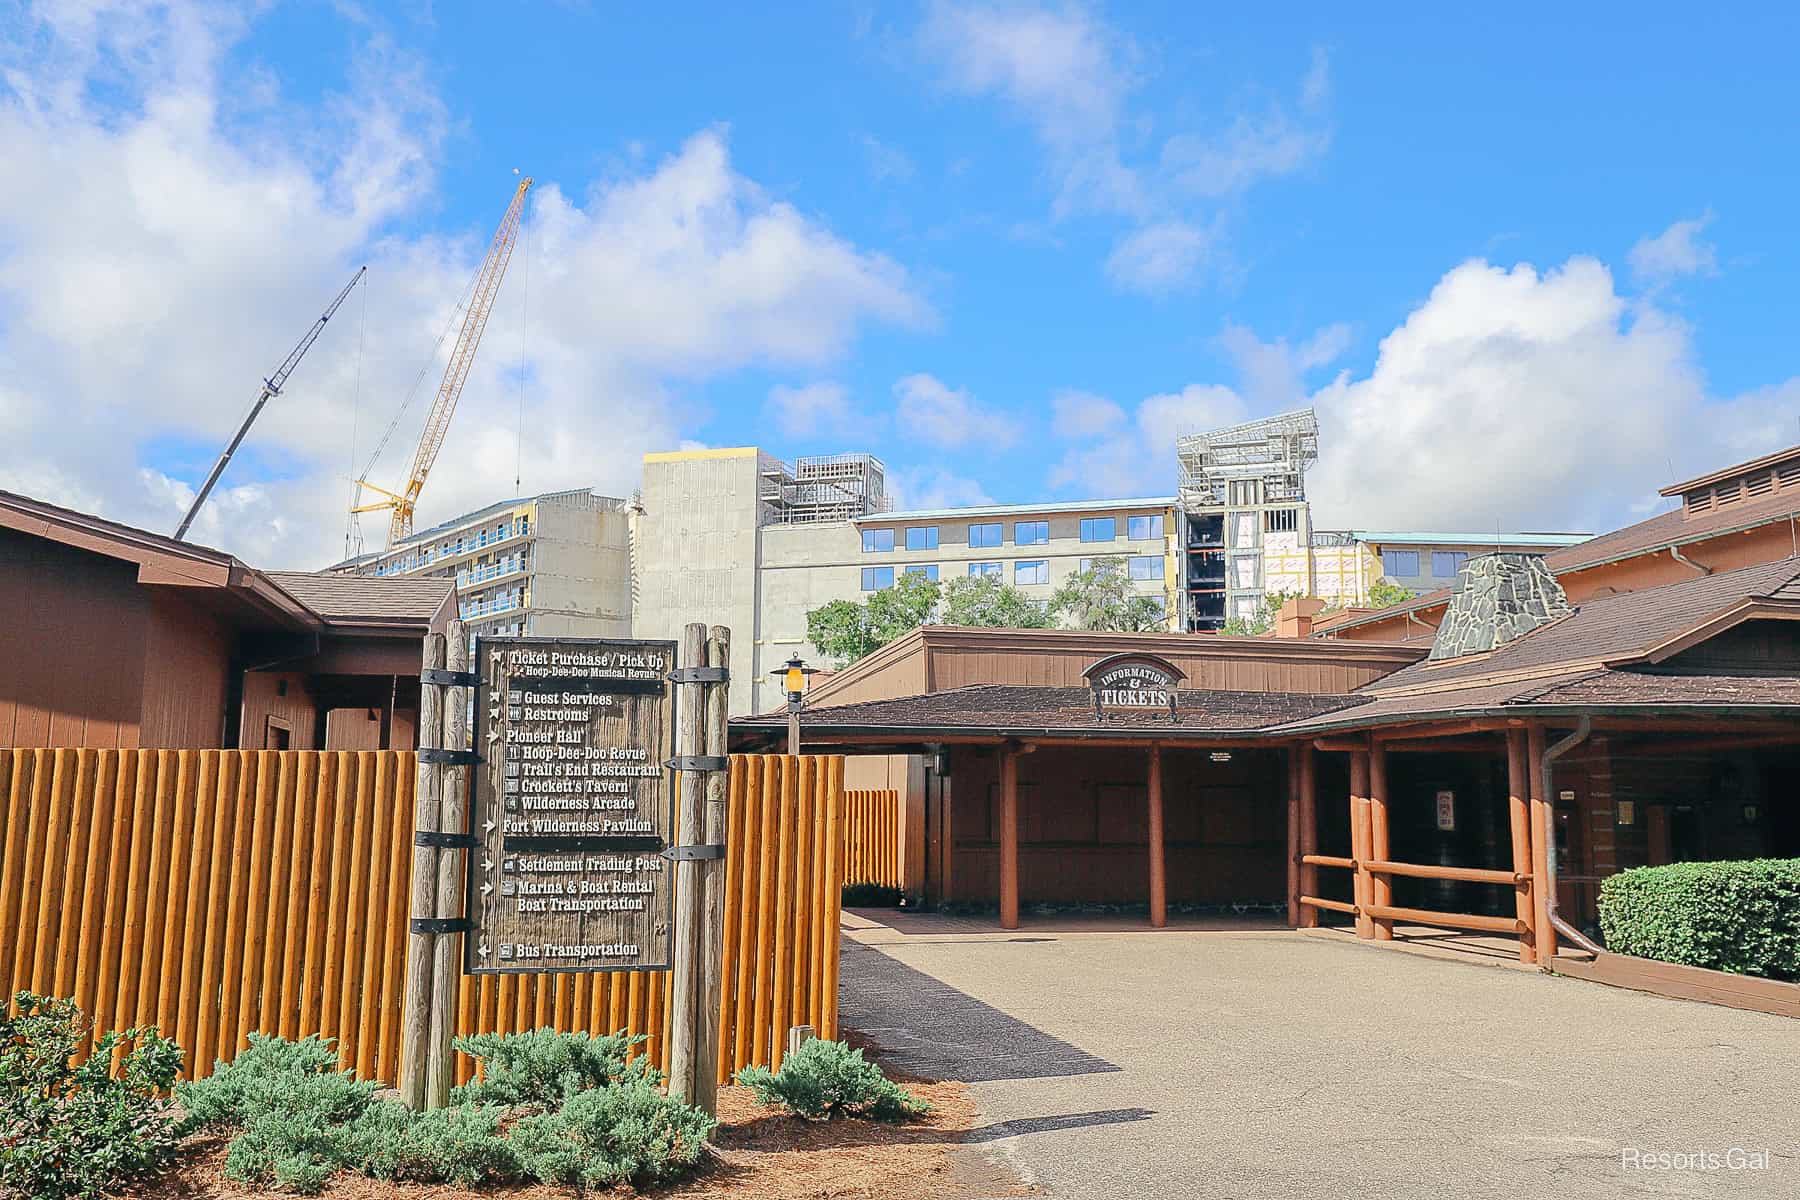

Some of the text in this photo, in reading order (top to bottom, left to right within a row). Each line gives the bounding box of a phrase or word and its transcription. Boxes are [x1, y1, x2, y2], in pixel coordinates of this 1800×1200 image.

[511, 652, 548, 665] Ticket
[552, 652, 608, 666] Purchase
[619, 654, 645, 667] Pick
[648, 654, 664, 670] Up
[526, 666, 657, 679] Hoop-Dee-Doo Musical Revue
[1101, 668, 1168, 686] INFORMATION
[1129, 678, 1141, 689] &
[524, 692, 612, 705] Guest Services
[1101, 689, 1167, 706] TICKETS
[524, 707, 589, 723] Restrooms
[506, 730, 582, 744] Pioneer Hall
[523, 746, 646, 761] Hoop-Dee-Doo Revue
[522, 763, 661, 776] Trail's End Restaurant
[521, 780, 629, 793] Crockett's Tavern
[522, 796, 635, 810] Wilderness Arcade
[503, 819, 651, 832] Fort Wilderness Pavilion
[519, 859, 661, 873] Settlement Trading Post
[518, 880, 653, 894] Marina & Boat Rental
[517, 897, 643, 913] Boat Transportation
[516, 943, 638, 959] Bus Transportation
